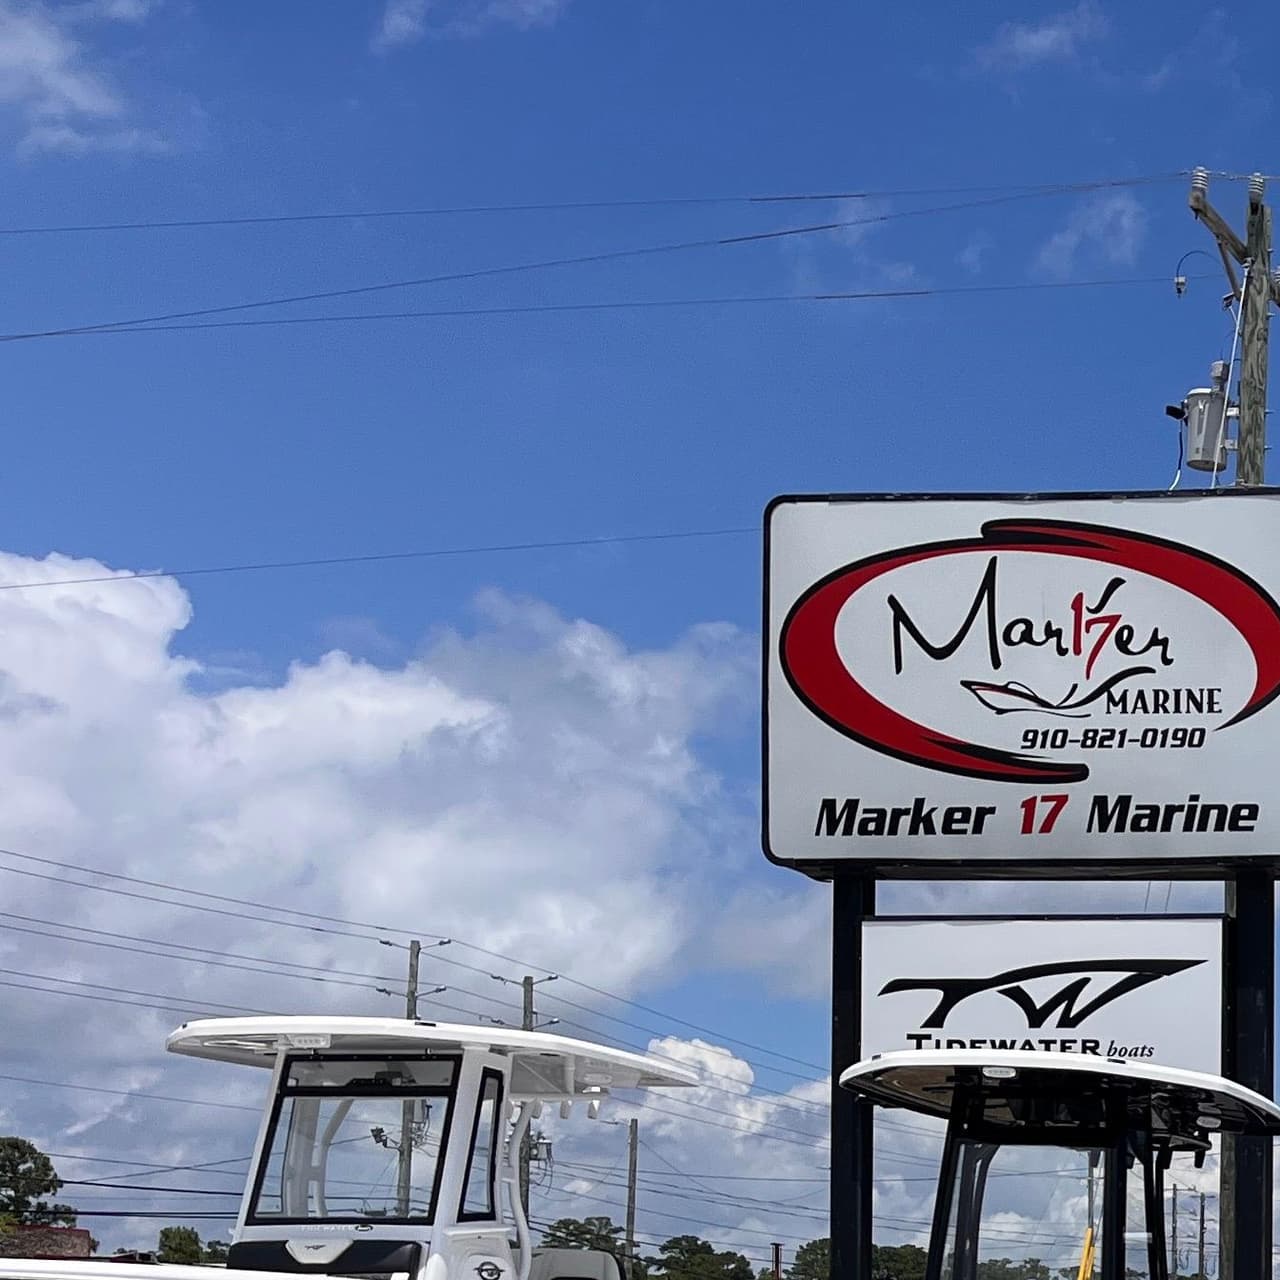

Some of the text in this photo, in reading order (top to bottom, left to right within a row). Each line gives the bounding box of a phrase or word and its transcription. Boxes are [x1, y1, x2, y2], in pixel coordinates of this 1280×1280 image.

[1104, 688, 1222, 714] MARINE
[1021, 728, 1206, 749] 910-821-0190
[815, 794, 1260, 836] Marker 17 Marine
[1106, 1040, 1155, 1058] boats
